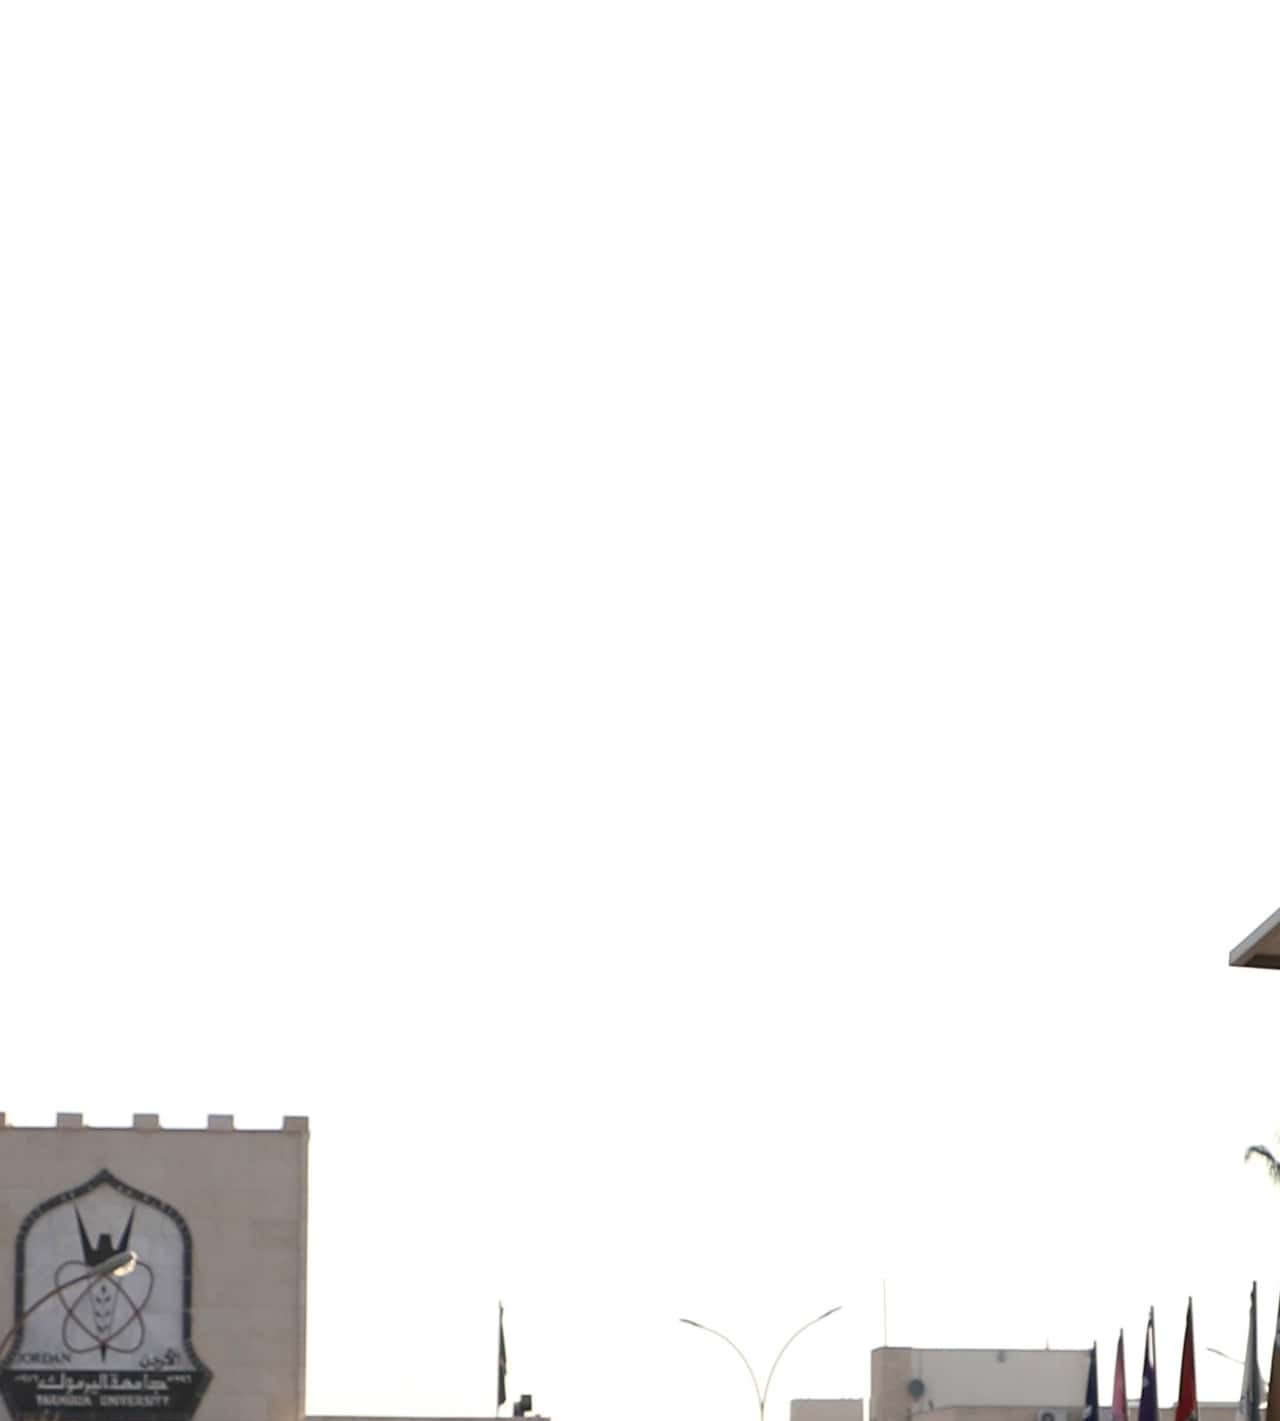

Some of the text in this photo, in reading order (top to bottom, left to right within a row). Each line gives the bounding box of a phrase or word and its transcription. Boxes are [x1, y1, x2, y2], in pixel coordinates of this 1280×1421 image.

[36, 1372, 109, 1396] اليرموك
[110, 1372, 168, 1395] جامعة
[99, 1394, 170, 1407] UNIVERSITY
